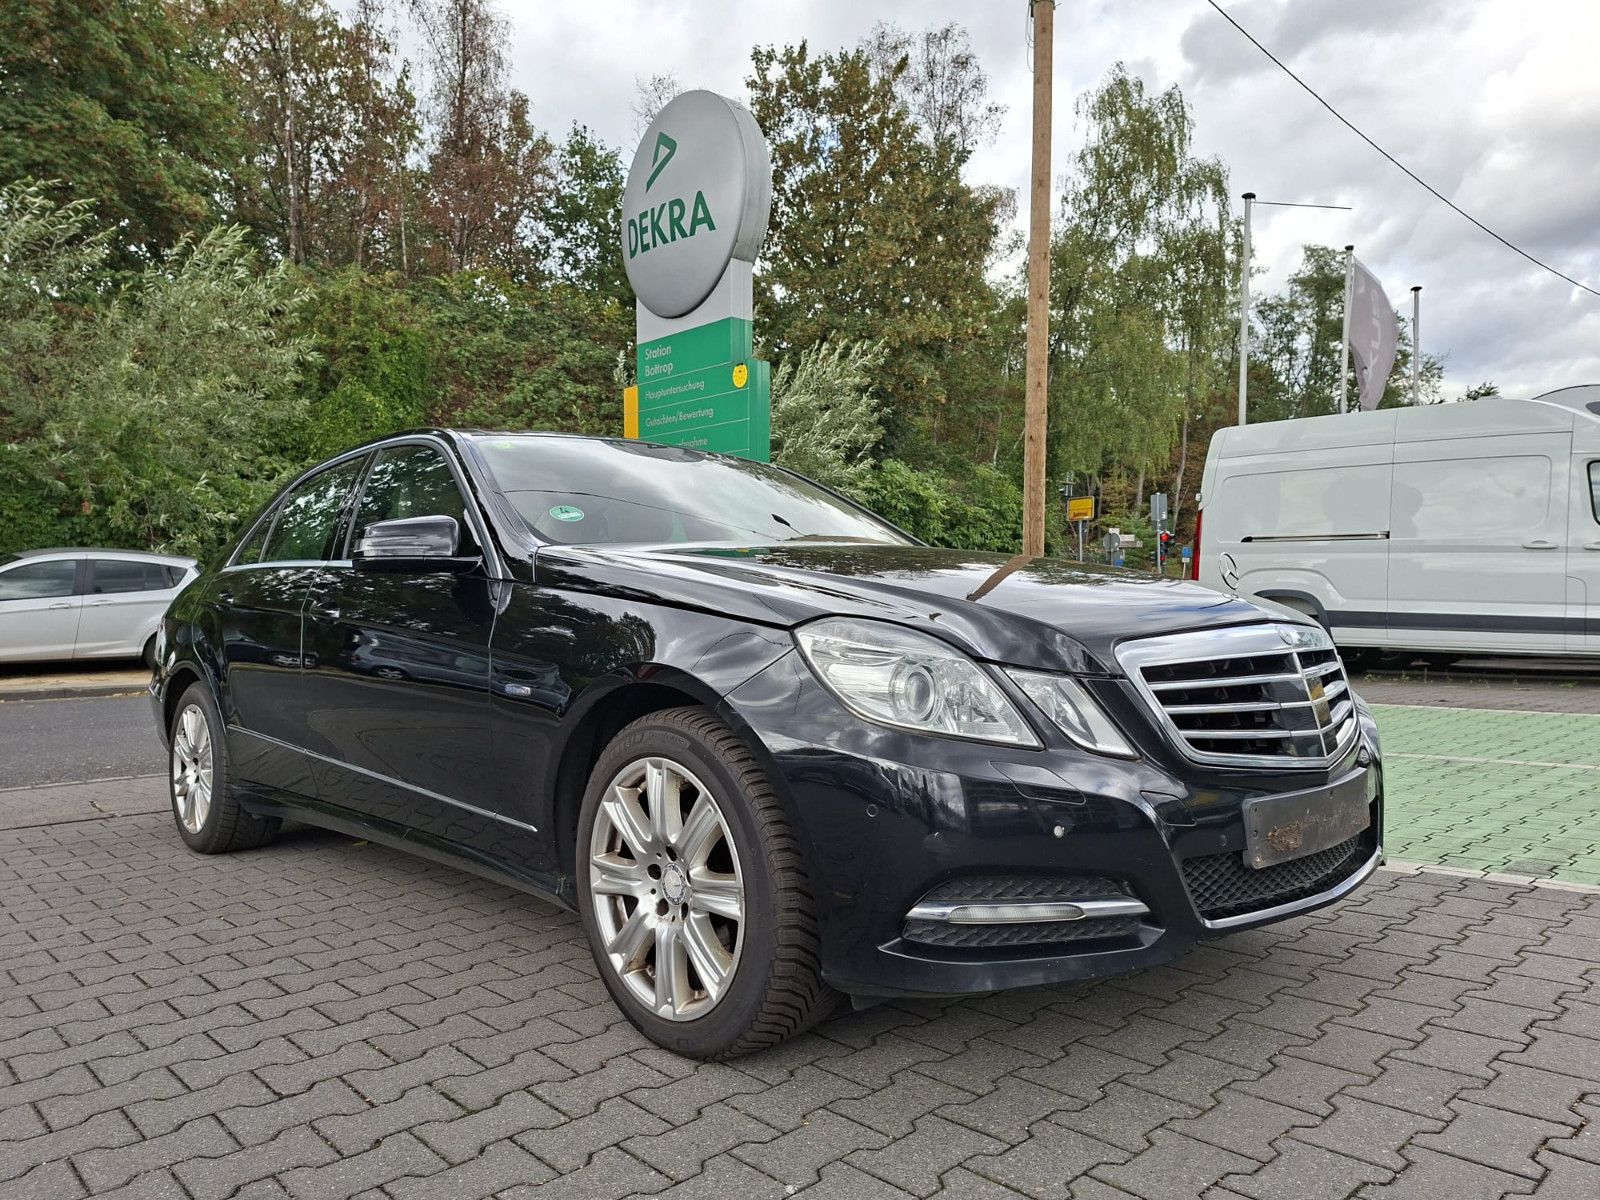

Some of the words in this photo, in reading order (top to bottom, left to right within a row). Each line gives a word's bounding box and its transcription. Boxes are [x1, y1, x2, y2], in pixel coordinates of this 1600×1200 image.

[627, 190, 717, 260] DEKRA
[645, 345, 672, 360] Station
[645, 362, 674, 376] Bottrop
[645, 379, 705, 400] Hauptuntersuchung
[646, 408, 714, 427] Gutachten/Bewertung
